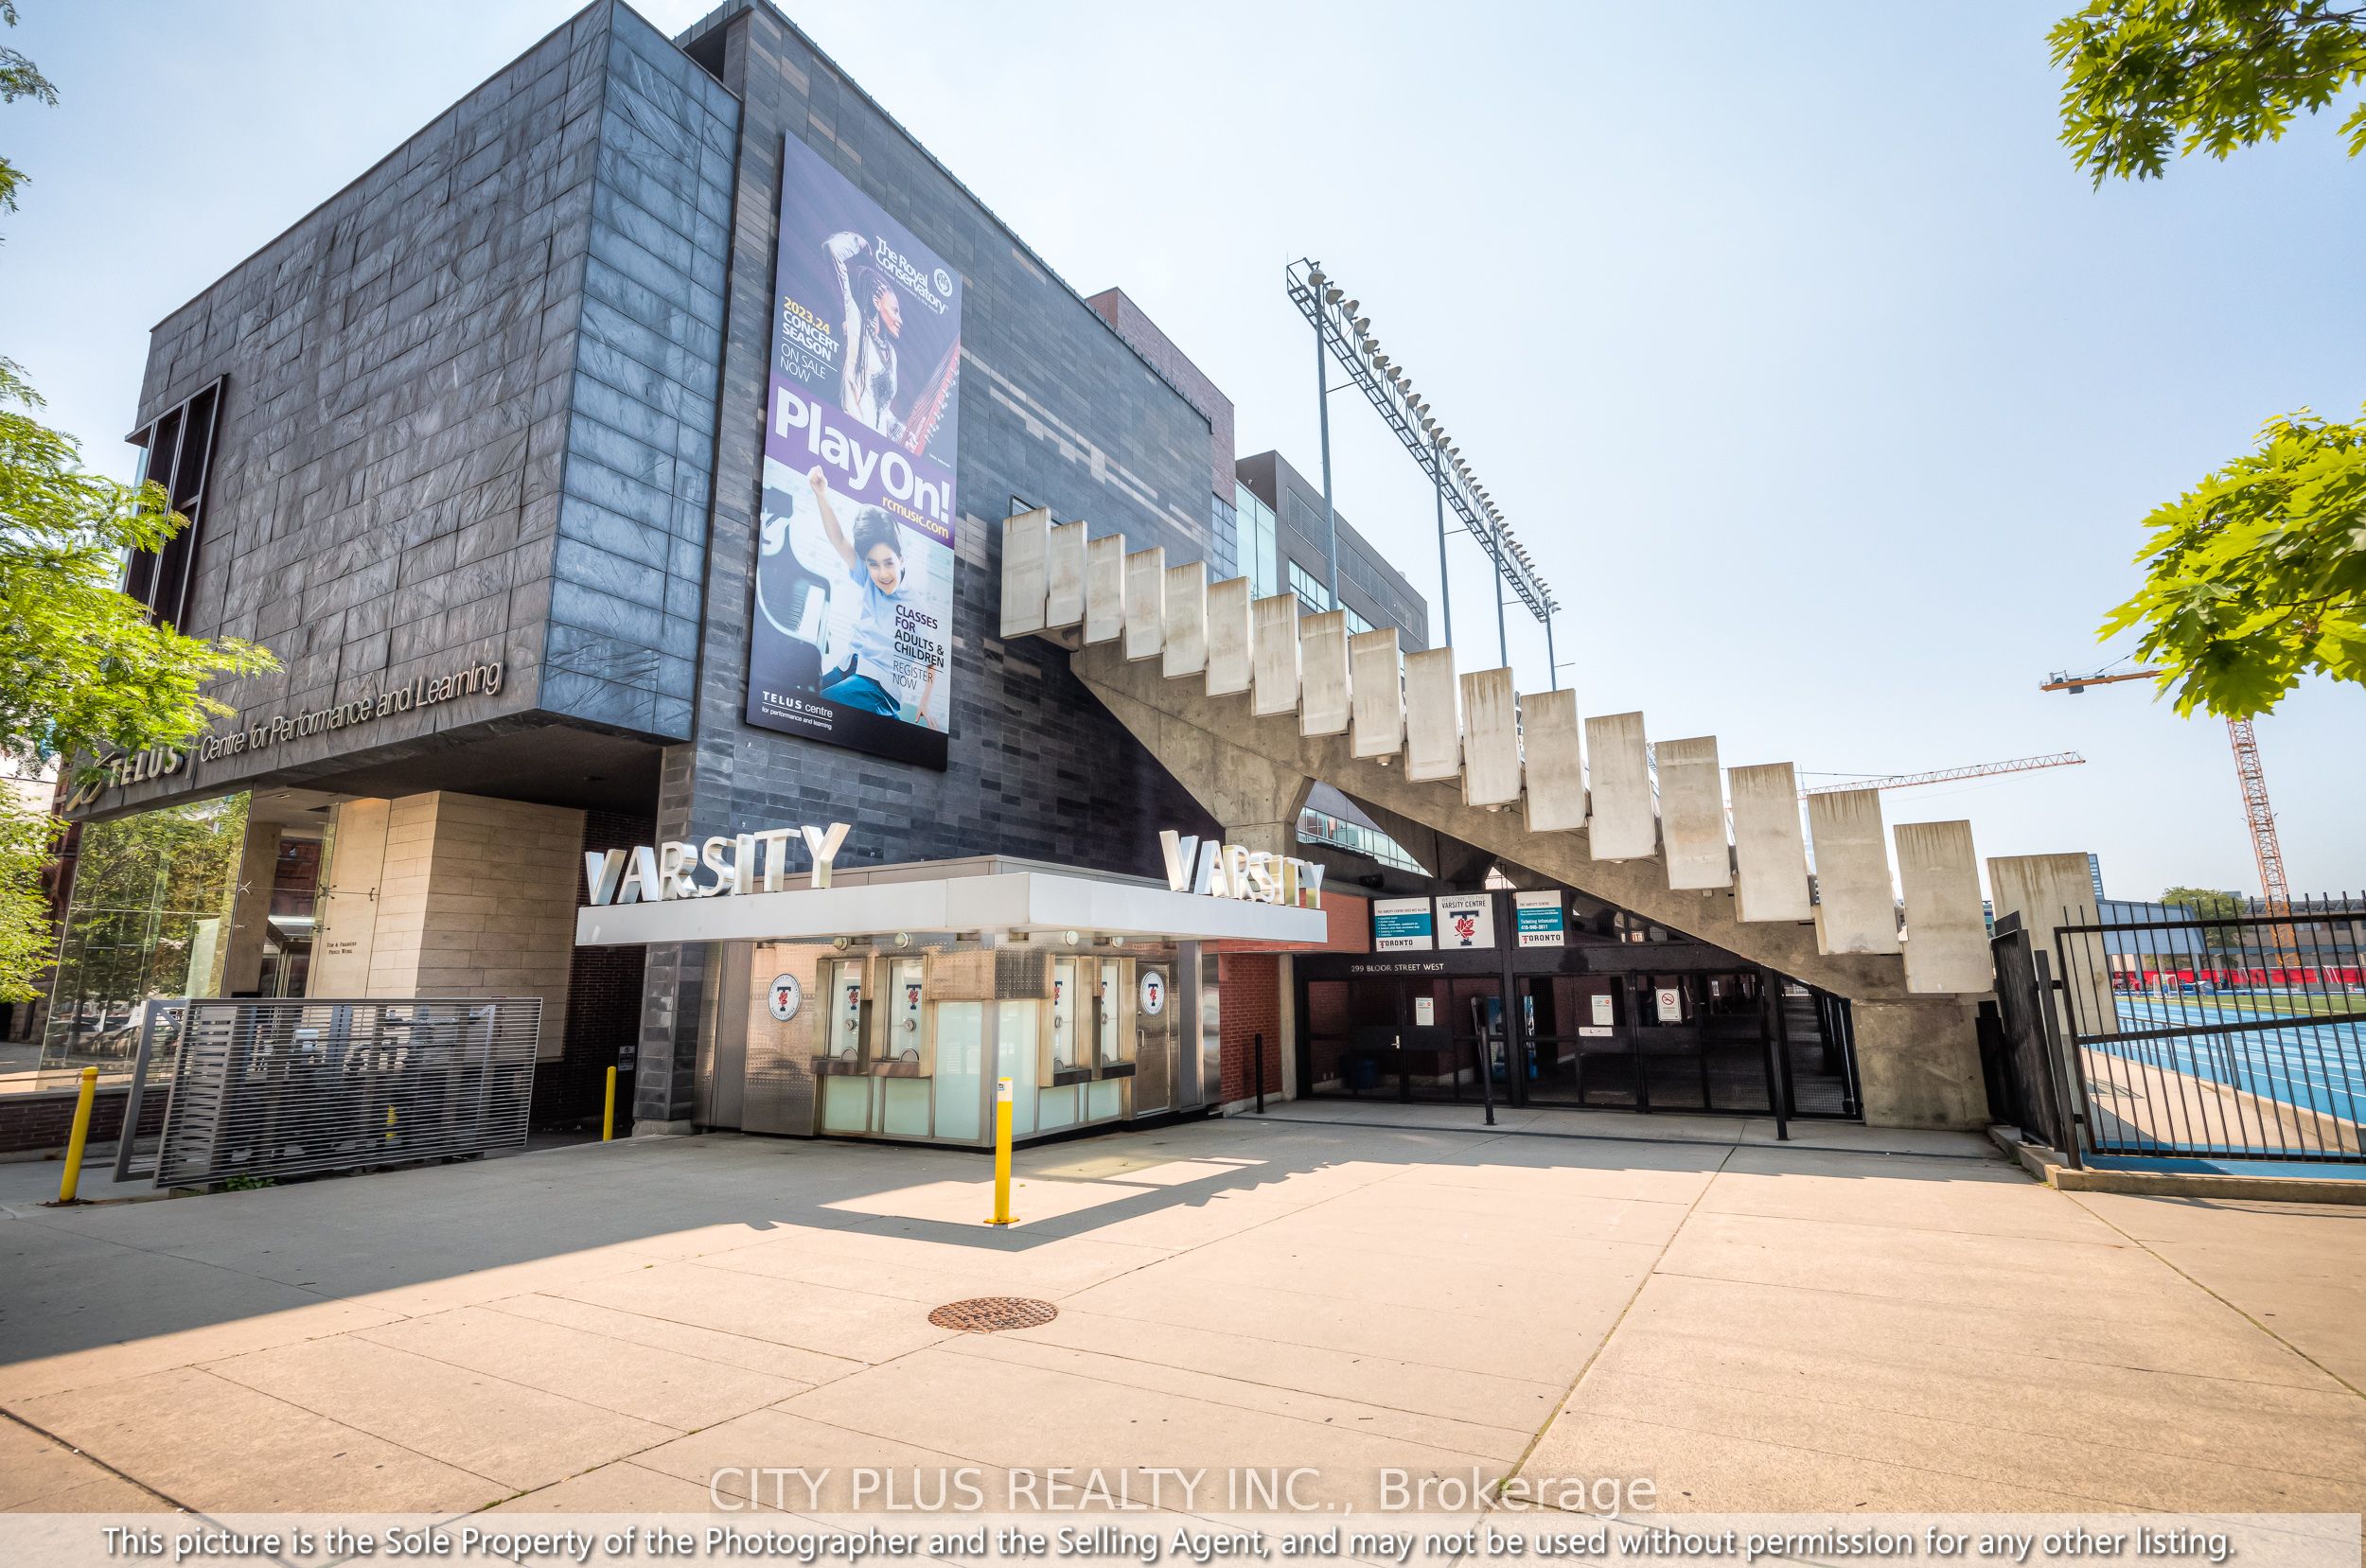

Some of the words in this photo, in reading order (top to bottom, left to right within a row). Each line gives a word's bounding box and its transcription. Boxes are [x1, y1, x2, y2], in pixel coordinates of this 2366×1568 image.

[876, 236, 897, 263] The
[899, 255, 927, 288] Royal
[875, 249, 945, 314] Conservatory
[784, 296, 830, 335] 2023.24
[782, 322, 831, 361] SEASON
[783, 309, 839, 353] CONCERT
[780, 356, 811, 382] NOW
[781, 344, 800, 362] ON
[801, 355, 826, 379] SALE
[882, 496, 949, 539] rcmusic.com
[894, 616, 916, 633] FOR
[895, 604, 938, 630] CLASSES
[894, 628, 934, 652] ADULTS
[936, 644, 945, 656] &
[894, 641, 945, 668] CHILDREN
[892, 660, 933, 684] REGISTER
[892, 673, 917, 691] NOW
[201, 731, 248, 763] Centre
[249, 722, 272, 750] for
[270, 697, 375, 745] Performance
[376, 678, 415, 717] and
[415, 660, 503, 708] Learning
[762, 690, 803, 710] TELUS
[804, 703, 833, 718] centre
[769, 709, 803, 722] performance
[813, 719, 833, 731] learning
[109, 746, 180, 788] TELUS
[584, 821, 852, 906] VARSITY
[1158, 829, 1326, 909] VARSITY
[1441, 901, 1464, 909] VARSITY
[1465, 900, 1486, 908] CENTRE
[1379, 939, 1414, 949] TORONTO
[1522, 934, 1562, 944] TORONTO
[1366, 964, 1392, 973] BLOOR
[1394, 963, 1421, 972] STREET
[1422, 962, 1444, 971] WEST
